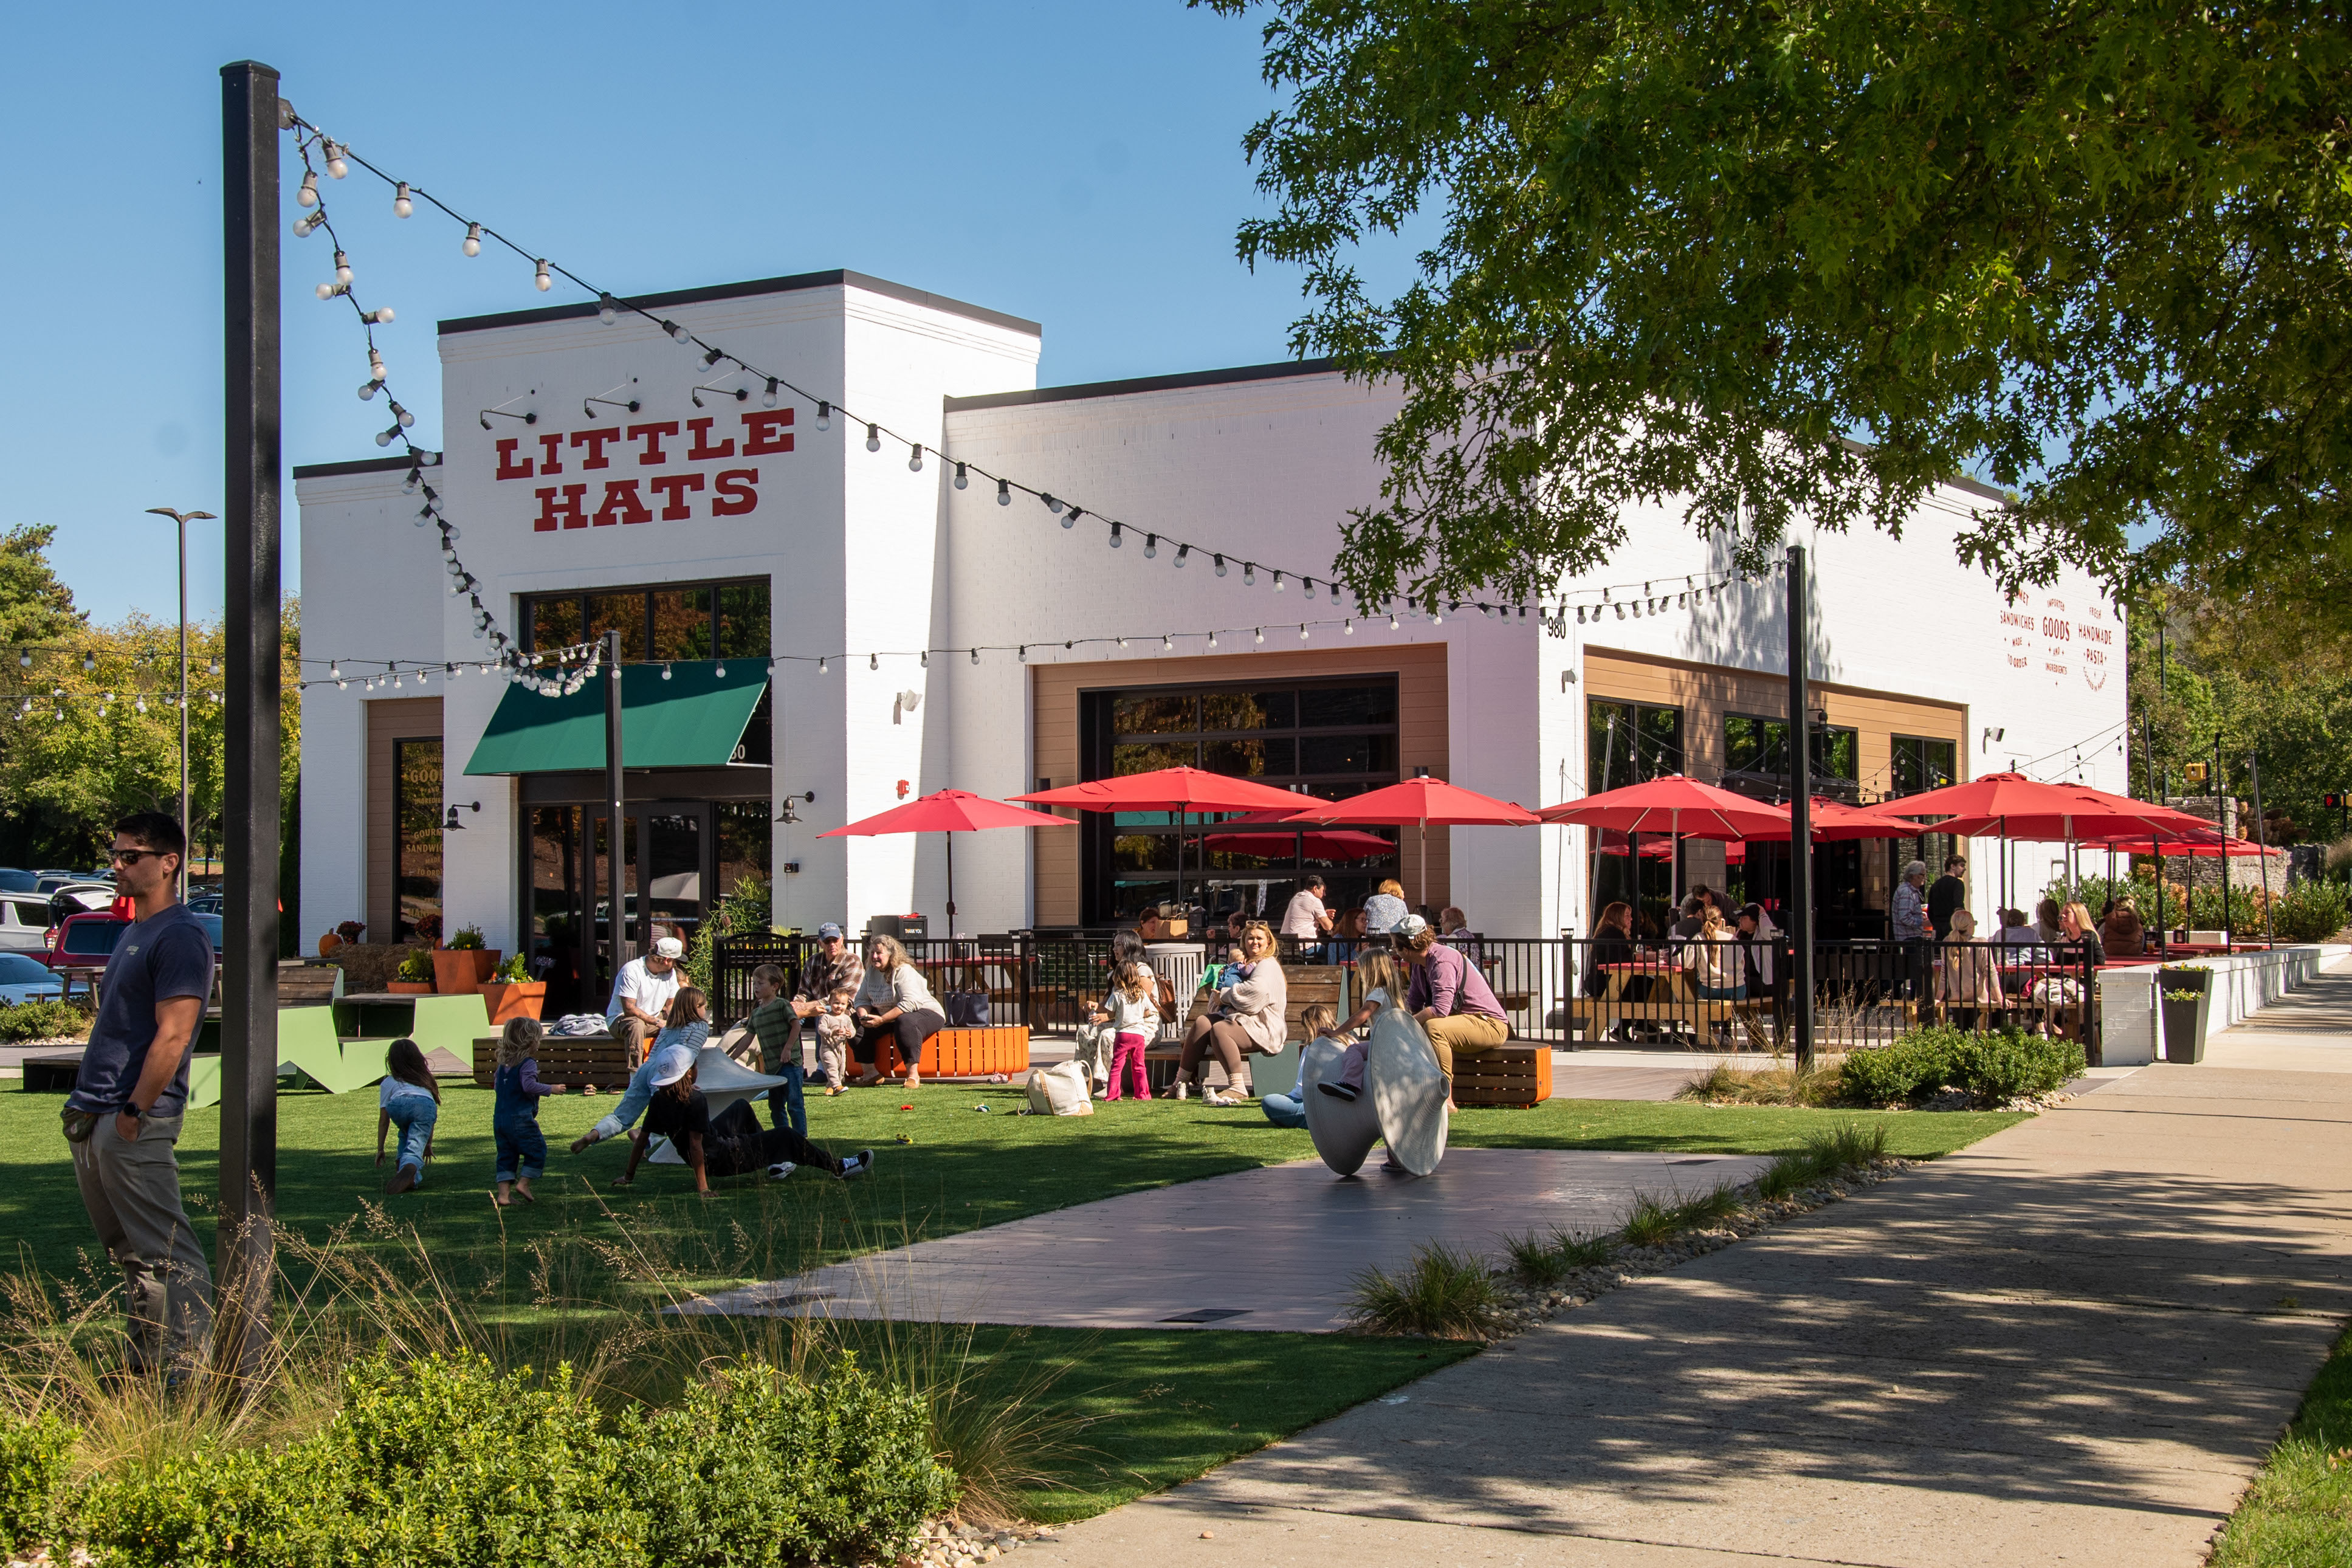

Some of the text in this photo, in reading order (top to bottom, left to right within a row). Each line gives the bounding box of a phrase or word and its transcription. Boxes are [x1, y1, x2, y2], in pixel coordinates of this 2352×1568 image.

[496, 408, 794, 480] LITTLE
[534, 468, 758, 532] HATS
[2000, 610, 2034, 631] SANDWICHES
[2089, 607, 2101, 619] FRESH
[1548, 616, 1566, 639] 980
[2043, 616, 2070, 641] GOODS
[2079, 622, 2112, 645] HANDMADE
[2007, 653, 2013, 665] TO
[2086, 648, 2103, 665] PASTA
